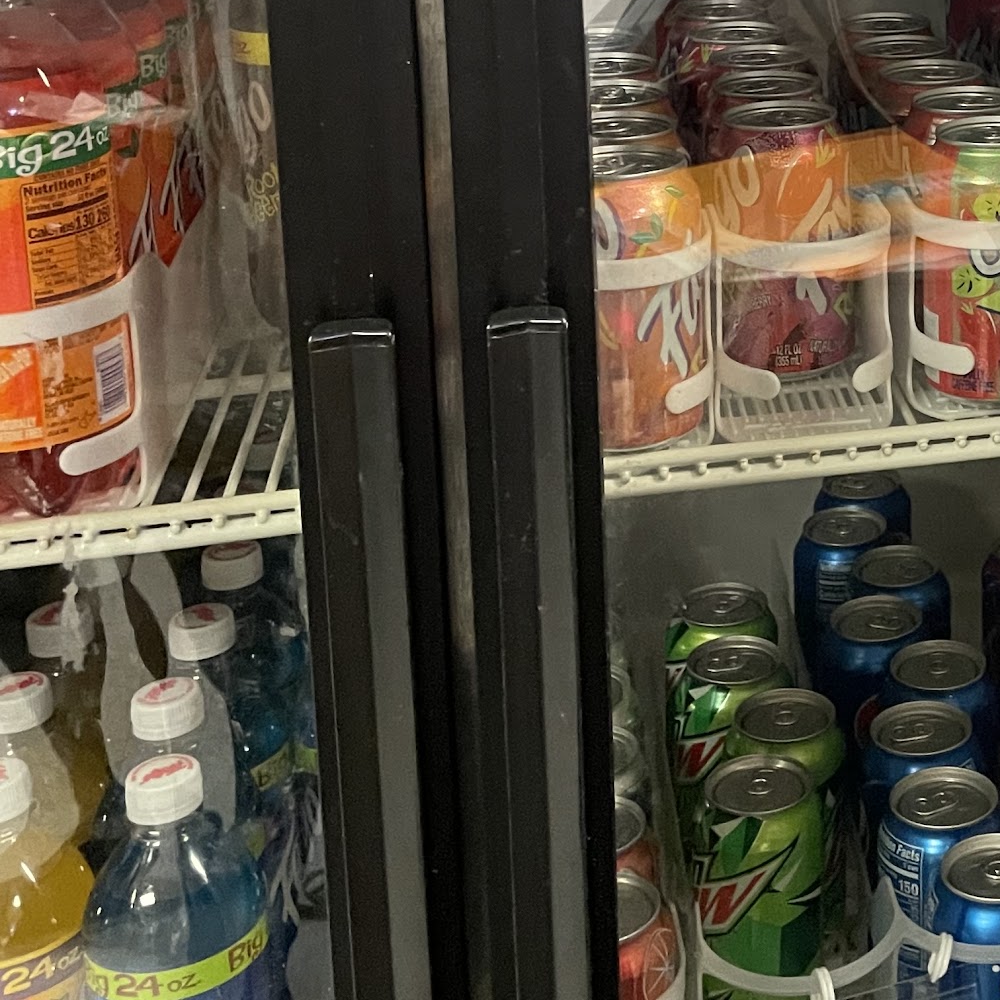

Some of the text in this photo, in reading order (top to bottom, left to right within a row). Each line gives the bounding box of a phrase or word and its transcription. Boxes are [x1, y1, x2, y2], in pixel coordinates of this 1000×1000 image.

[49, 125, 95, 161] 24
[23, 176, 82, 197] Nutrition
[74, 210, 95, 231] 130
[895, 844, 920, 863] Facts
[897, 879, 919, 897] 150
[2, 945, 82, 996] 24 oz
[114, 973, 162, 997] 24
[167, 972, 200, 993] oz
